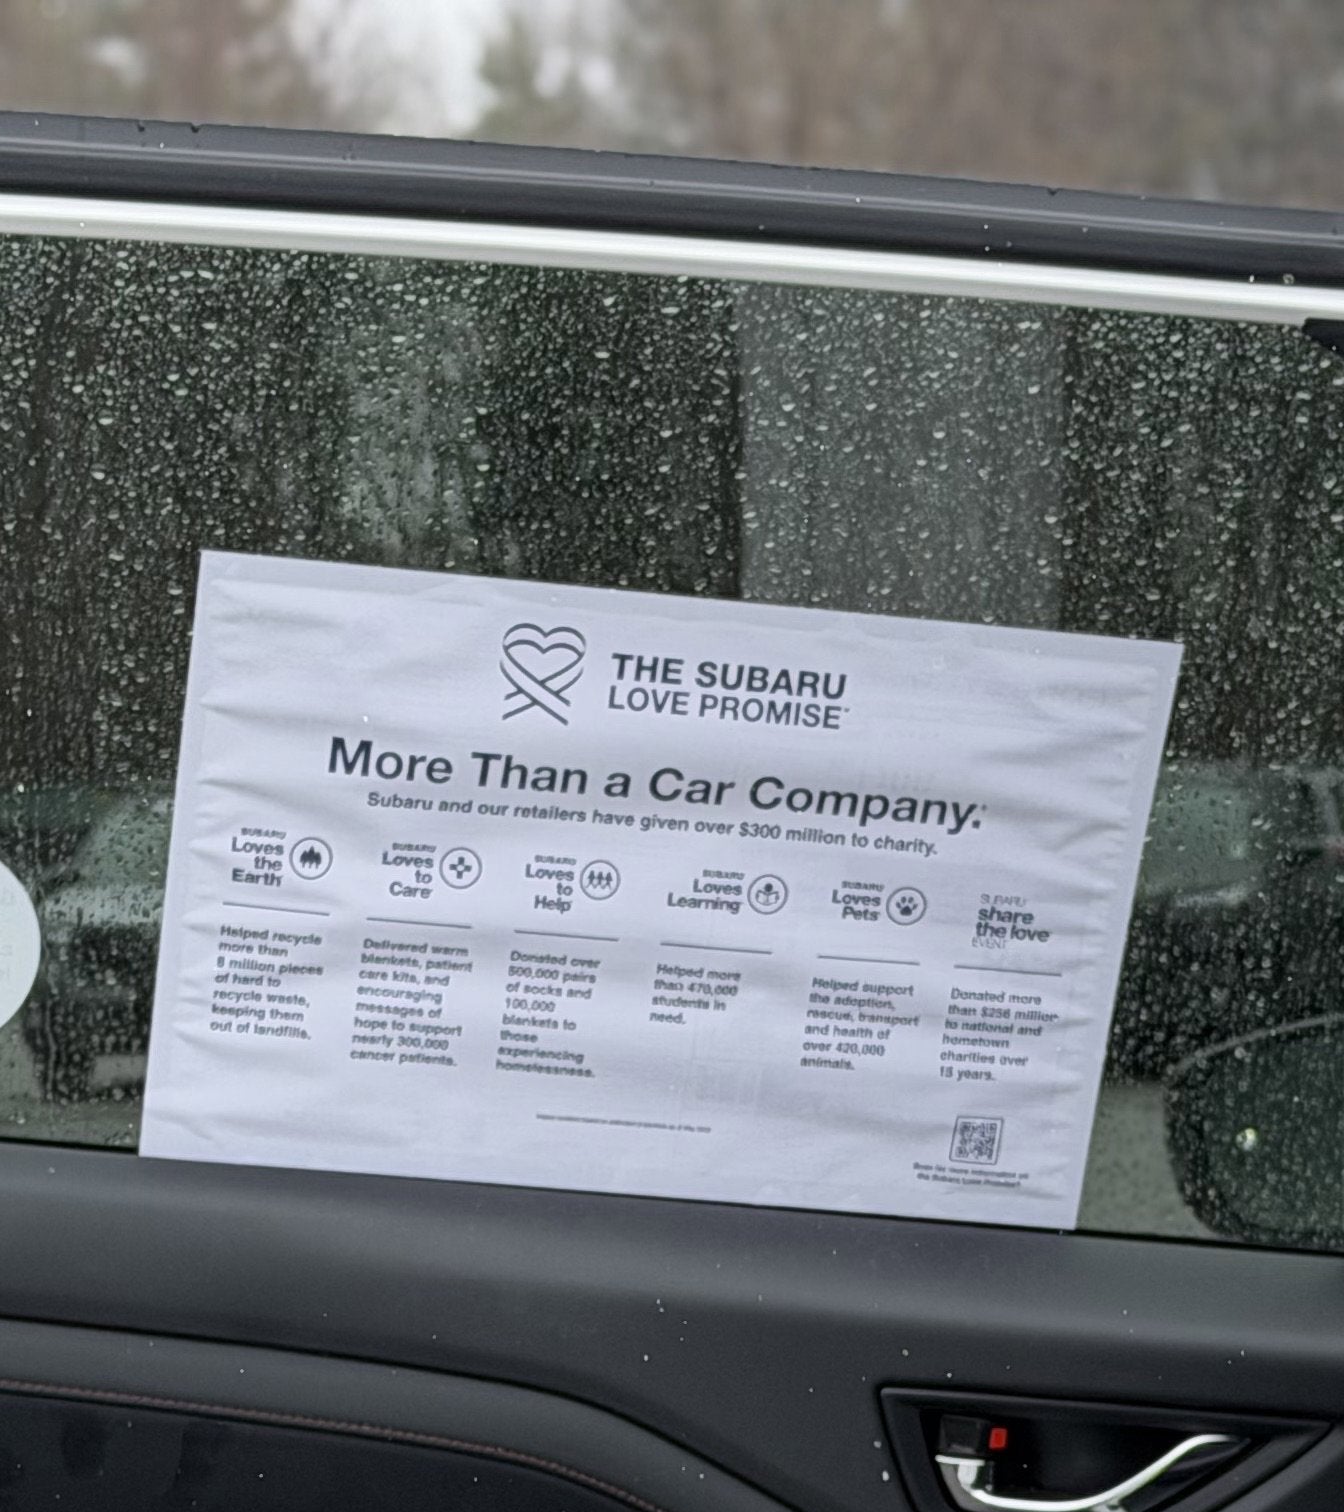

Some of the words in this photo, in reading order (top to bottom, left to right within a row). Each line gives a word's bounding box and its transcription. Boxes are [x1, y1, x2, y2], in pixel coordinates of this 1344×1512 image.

[611, 653, 685, 685] THE
[695, 661, 847, 699] SUBARU
[608, 686, 689, 715] LOVE
[328, 736, 453, 784] More
[471, 751, 588, 795] Than
[604, 771, 632, 798] a
[649, 767, 736, 805] Car
[367, 791, 434, 811] Subaru
[438, 799, 474, 815] and
[478, 803, 508, 817] our
[513, 804, 587, 822] retailers
[592, 809, 635, 827] have
[639, 814, 689, 832] given
[694, 820, 733, 835] over
[738, 822, 781, 839] $300
[785, 827, 846, 846] million
[851, 832, 869, 848] to
[873, 834, 938, 857] charity.
[241, 827, 286, 840] SUBARU
[231, 836, 284, 856] Loves
[392, 842, 437, 853] SUBARU
[254, 854, 283, 871] the
[381, 851, 434, 869] Loves
[534, 854, 577, 865] SUBARU
[231, 868, 281, 887] Earth
[414, 869, 432, 884] to
[525, 864, 574, 881] Loves
[389, 881, 432, 899] Care
[556, 881, 573, 896] to
[693, 878, 742, 896] Loves
[841, 880, 885, 892] SUBARU
[534, 895, 572, 914] Help
[667, 892, 741, 915] Learning
[832, 889, 881, 907] Loves
[842, 906, 879, 922] Pets
[978, 906, 1034, 925] share
[220, 925, 269, 940] Helped
[272, 931, 323, 946] recycle
[975, 921, 1007, 939] the
[1009, 923, 1050, 942] love
[218, 942, 254, 954] more
[257, 944, 289, 957] than
[363, 938, 428, 954] Delivered
[431, 945, 469, 957] warm
[229, 958, 275, 973] million
[278, 963, 324, 976] pieces
[425, 959, 473, 973] patient
[510, 949, 568, 966] Donated
[570, 958, 601, 969] over
[214, 972, 230, 983] of
[232, 973, 264, 986] hard
[267, 976, 281, 987] to
[358, 969, 388, 981] care
[424, 975, 450, 987] and
[562, 971, 597, 984] pairs
[656, 962, 704, 978] Helped
[706, 970, 741, 982] more
[505, 981, 521, 993] of
[523, 984, 563, 997] socks
[566, 988, 593, 1000] and
[654, 979, 684, 992] than
[812, 977, 859, 992] Helped
[862, 983, 914, 997] support
[213, 989, 262, 1003] recycle
[266, 992, 310, 1008] waste,
[356, 985, 443, 1005] encouraging
[651, 995, 709, 1010] students
[713, 999, 727, 1011] in
[809, 992, 830, 1005] the
[950, 987, 1006, 1004] Donated
[1008, 994, 1042, 1006] more
[211, 1003, 266, 1020] keeping
[269, 1008, 304, 1021] them
[355, 1001, 424, 1019] messages
[428, 1007, 443, 1019] of
[505, 997, 556, 1013] 100,000
[948, 1004, 977, 1017] than
[209, 1020, 232, 1032] out
[236, 1021, 251, 1034] of
[354, 1016, 388, 1032] hope
[391, 1020, 405, 1031] to
[409, 1022, 463, 1037] support
[502, 1013, 559, 1030] blankets
[562, 1019, 577, 1031] to
[857, 1012, 920, 1027] transport
[944, 1018, 958, 1030] to
[961, 1021, 1014, 1034] national
[1017, 1026, 1043, 1037] and
[351, 1034, 394, 1048] nearly
[500, 1029, 538, 1043] those
[804, 1024, 830, 1036] and
[832, 1025, 873, 1039] health
[877, 1029, 891, 1040] of
[942, 1033, 1010, 1048] hometown
[350, 1049, 395, 1062] cancer
[497, 1046, 584, 1065] experiencing
[802, 1041, 832, 1052] over
[939, 1050, 995, 1064] charities
[999, 1056, 1029, 1066] over
